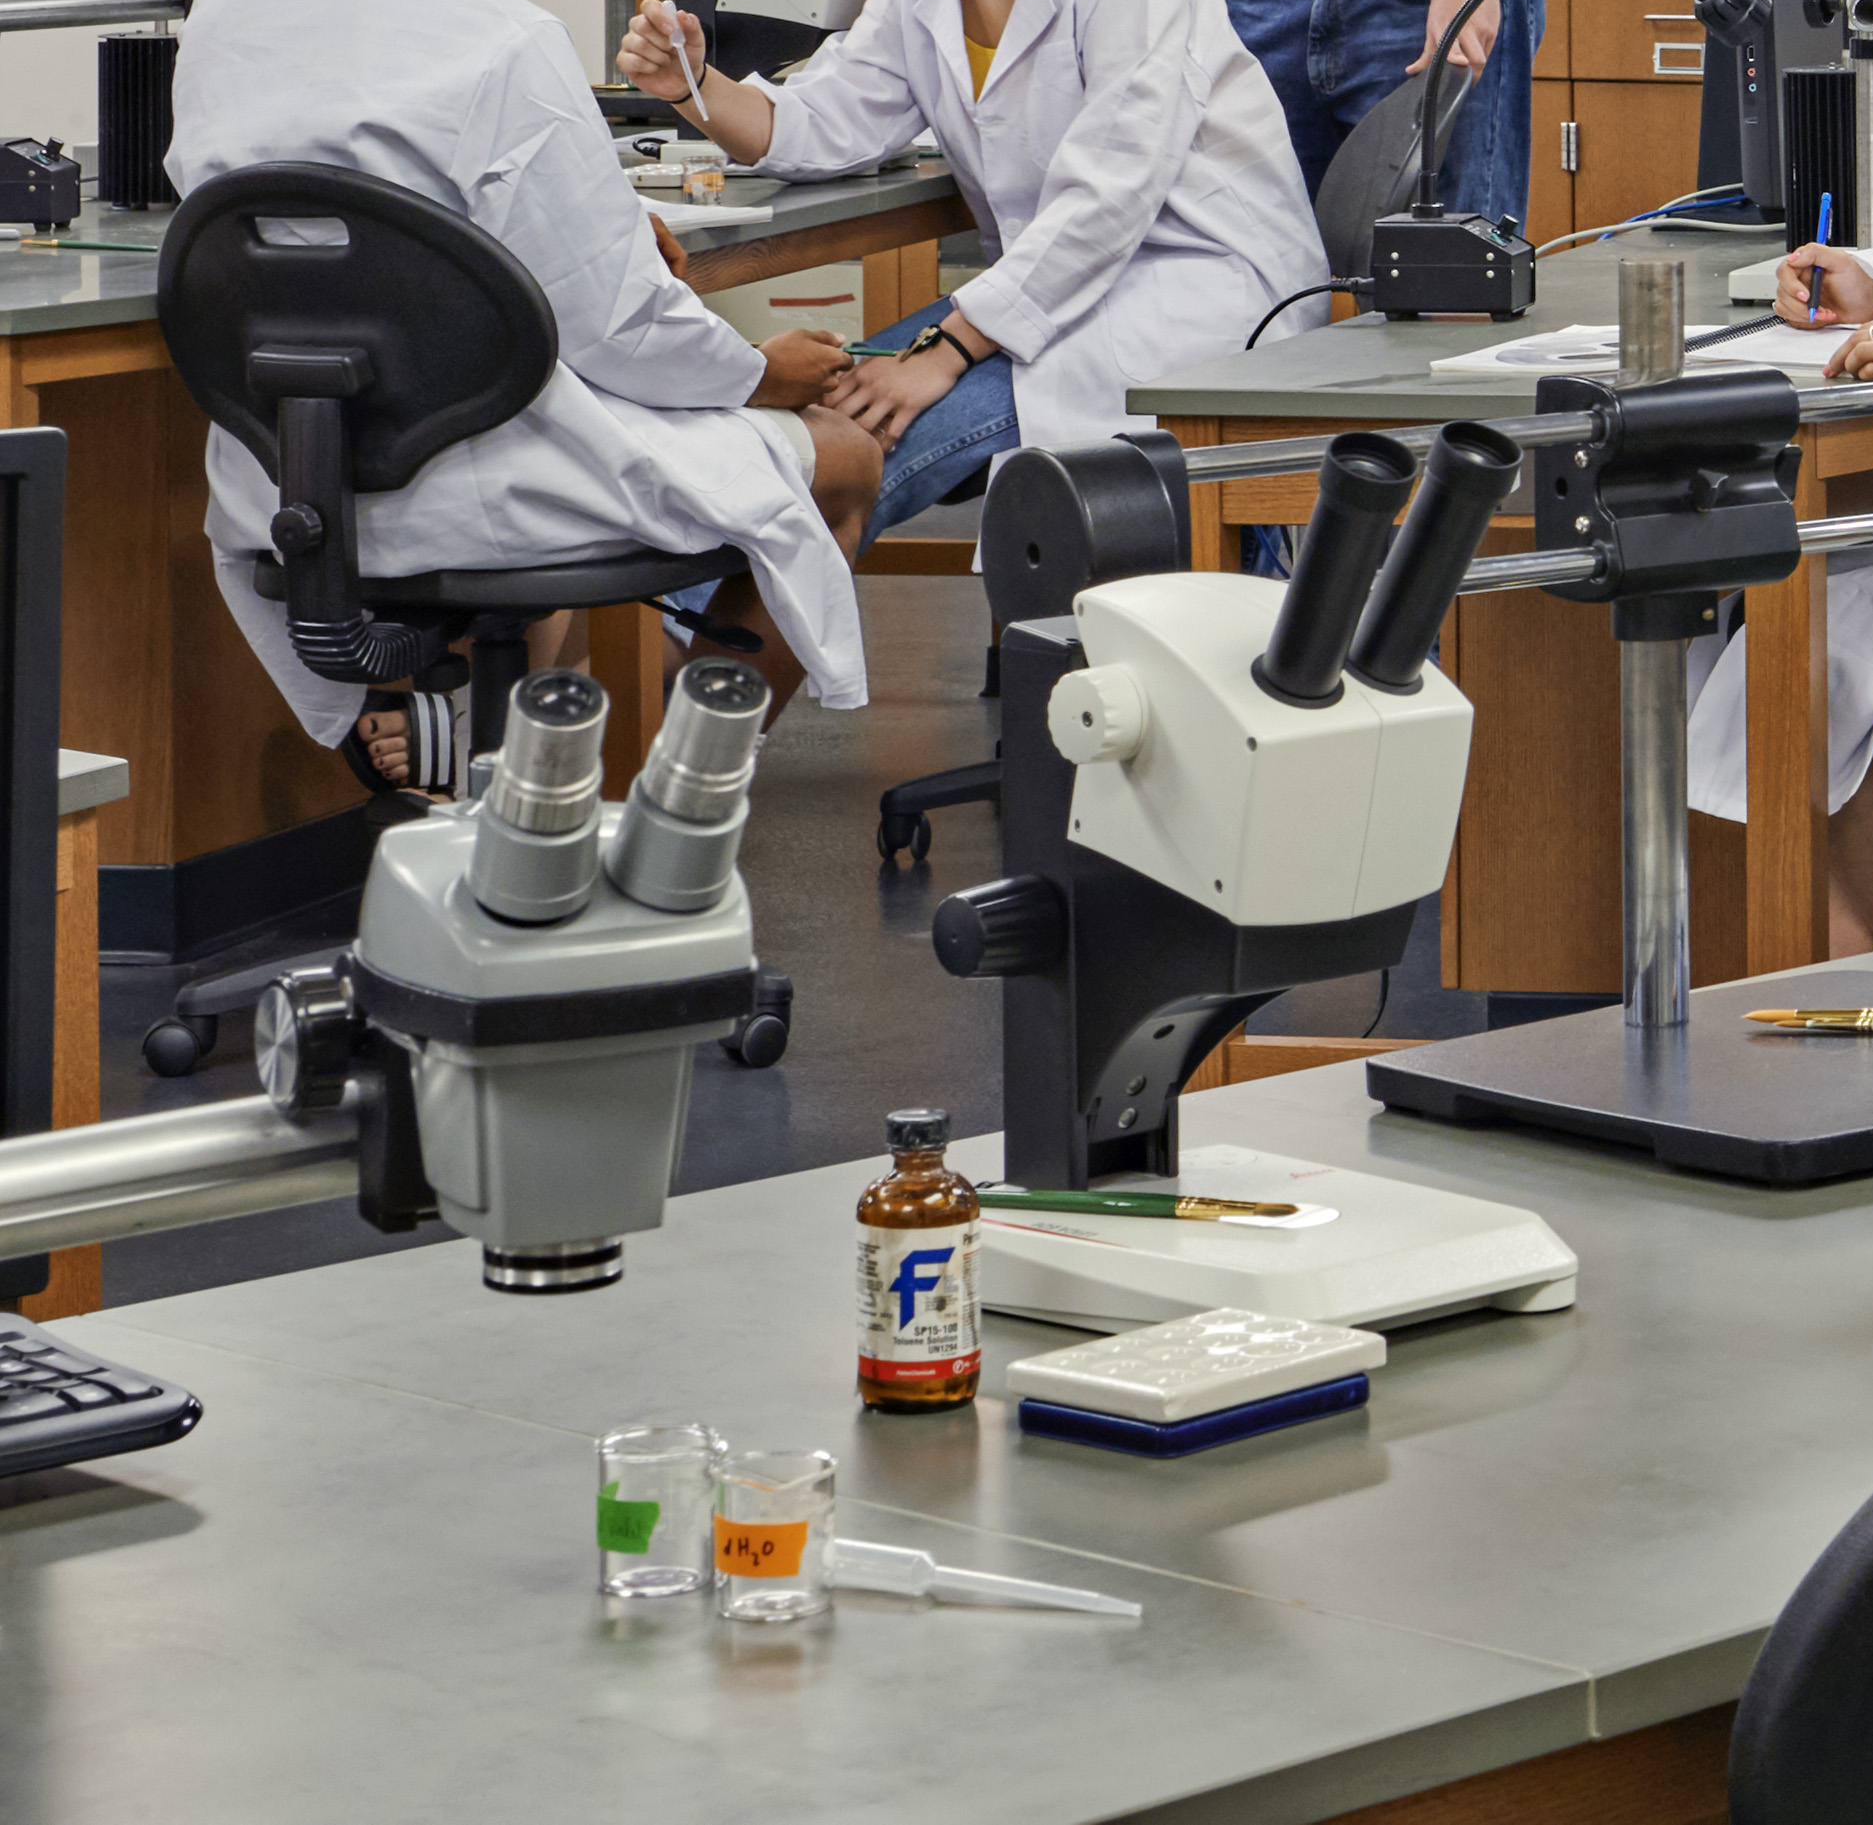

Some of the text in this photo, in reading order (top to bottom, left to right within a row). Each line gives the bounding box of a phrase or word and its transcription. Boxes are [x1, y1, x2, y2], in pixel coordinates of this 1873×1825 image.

[888, 1247, 956, 1331] F
[893, 1334, 958, 1345] Toluene Solution
[928, 1343, 958, 1354] UN1294
